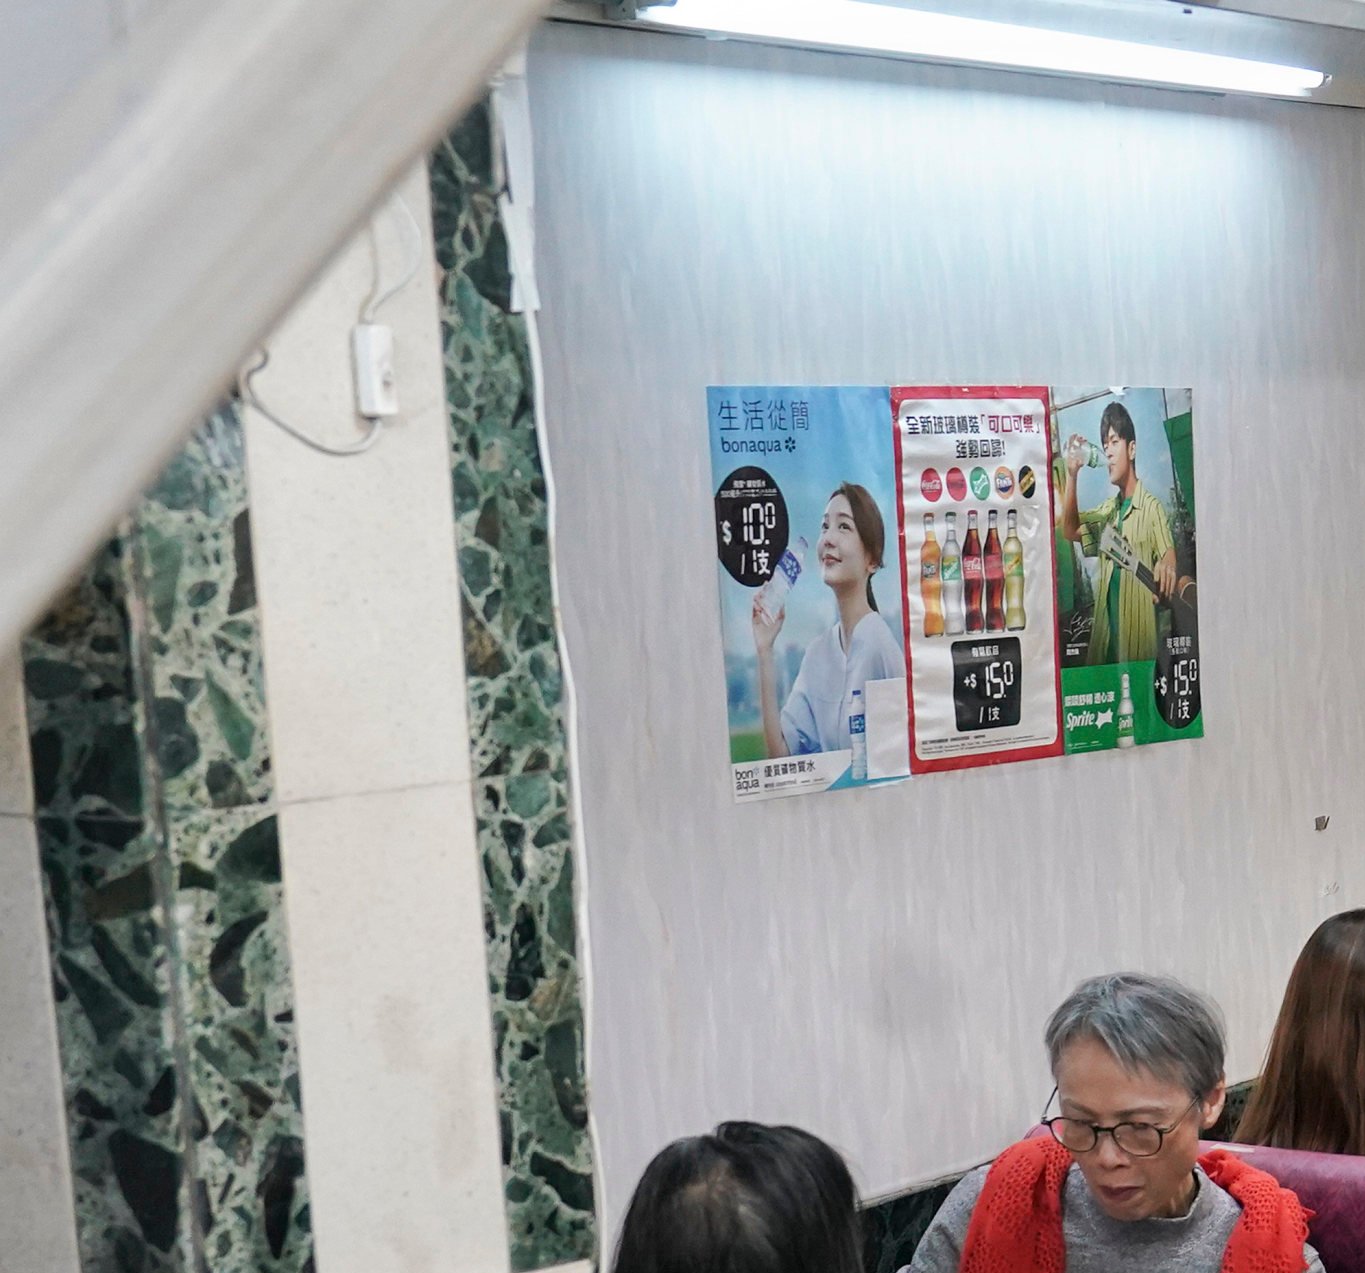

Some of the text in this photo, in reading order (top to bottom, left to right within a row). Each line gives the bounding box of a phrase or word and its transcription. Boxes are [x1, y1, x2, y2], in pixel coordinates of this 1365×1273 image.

[718, 400, 810, 432] 生活從簡
[720, 436, 782, 456] bonaqua
[1066, 711, 1096, 731] Sprite
[735, 768, 754, 781] bon
[736, 779, 760, 792] aqua
